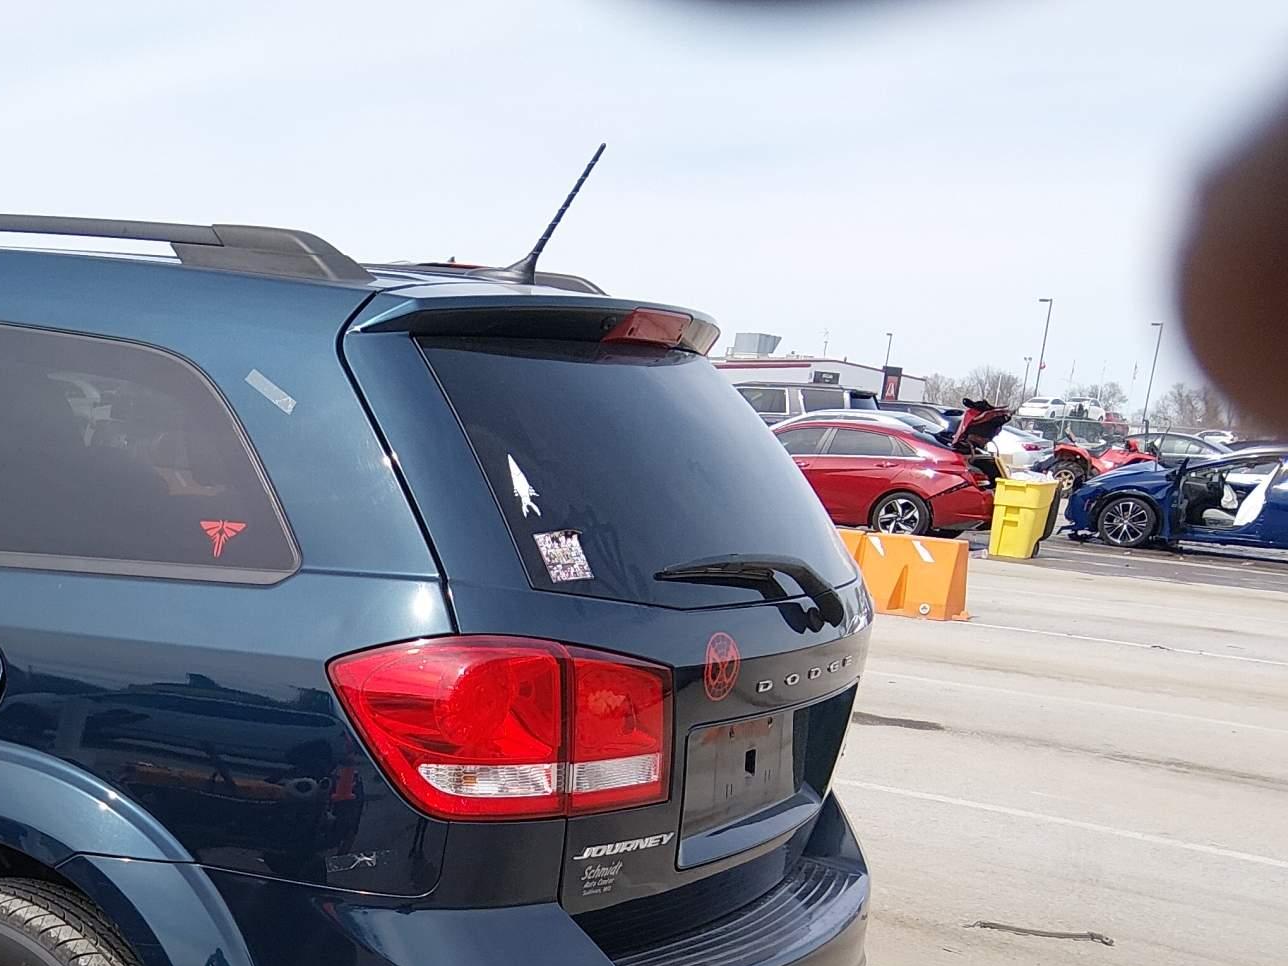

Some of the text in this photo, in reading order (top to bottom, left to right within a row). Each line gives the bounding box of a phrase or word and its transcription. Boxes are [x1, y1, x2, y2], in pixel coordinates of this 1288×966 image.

[756, 655, 853, 693] DODGE
[573, 832, 675, 860] JOURNEY
[581, 860, 623, 880] Schmidt
